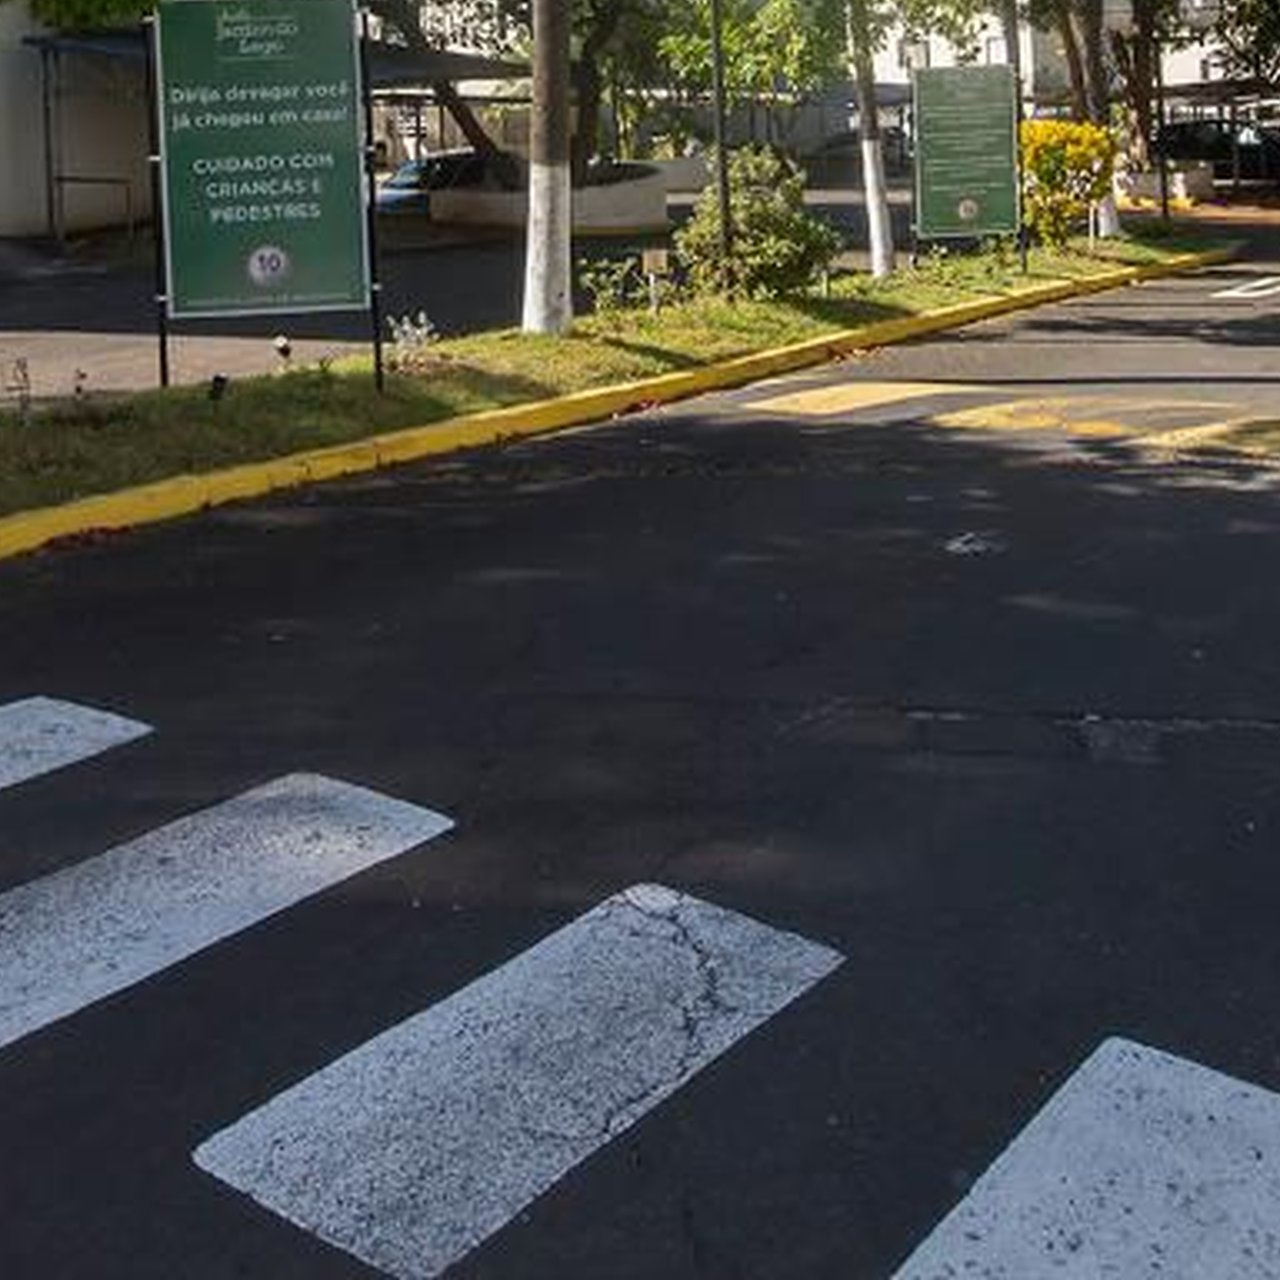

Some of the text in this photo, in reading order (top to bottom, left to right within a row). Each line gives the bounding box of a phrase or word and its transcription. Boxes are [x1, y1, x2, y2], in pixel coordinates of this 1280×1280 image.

[192, 153, 334, 174] CUIDADO COM
[210, 202, 321, 222] PEDESTRES
